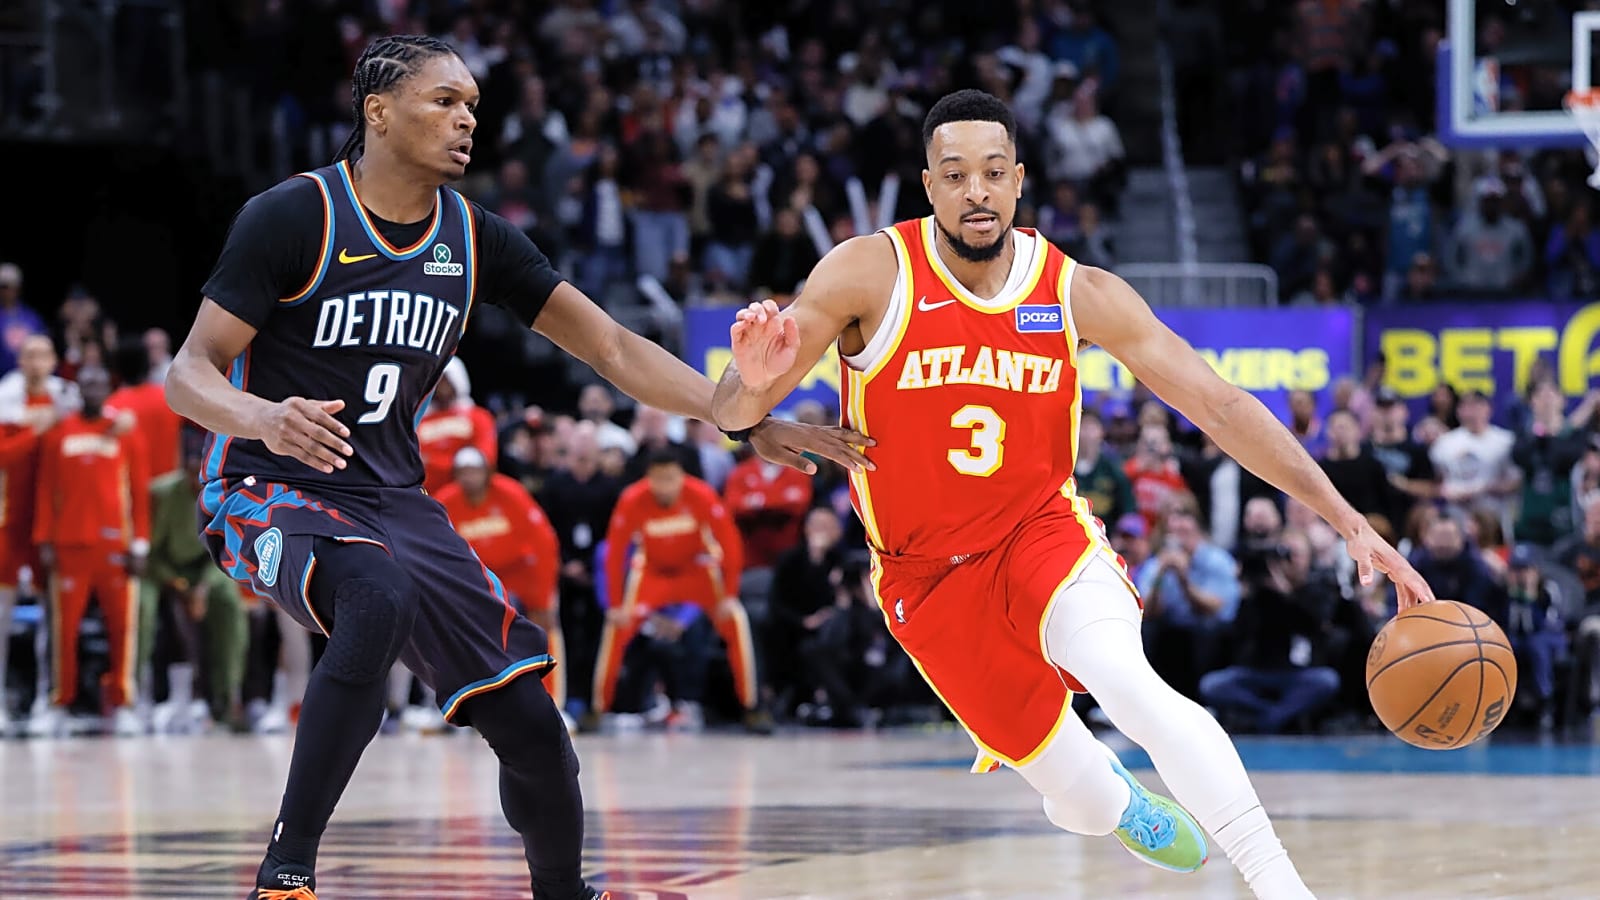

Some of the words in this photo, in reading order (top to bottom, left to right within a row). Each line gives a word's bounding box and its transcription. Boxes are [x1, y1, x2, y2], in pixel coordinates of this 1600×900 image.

[425, 264, 461, 273] StockX
[313, 291, 460, 355] DETROIT
[1020, 312, 1059, 326] paze
[357, 362, 402, 424] 9
[897, 345, 1063, 394] ATLANTA
[947, 404, 1006, 478] 3
[291, 874, 310, 882] CUT
